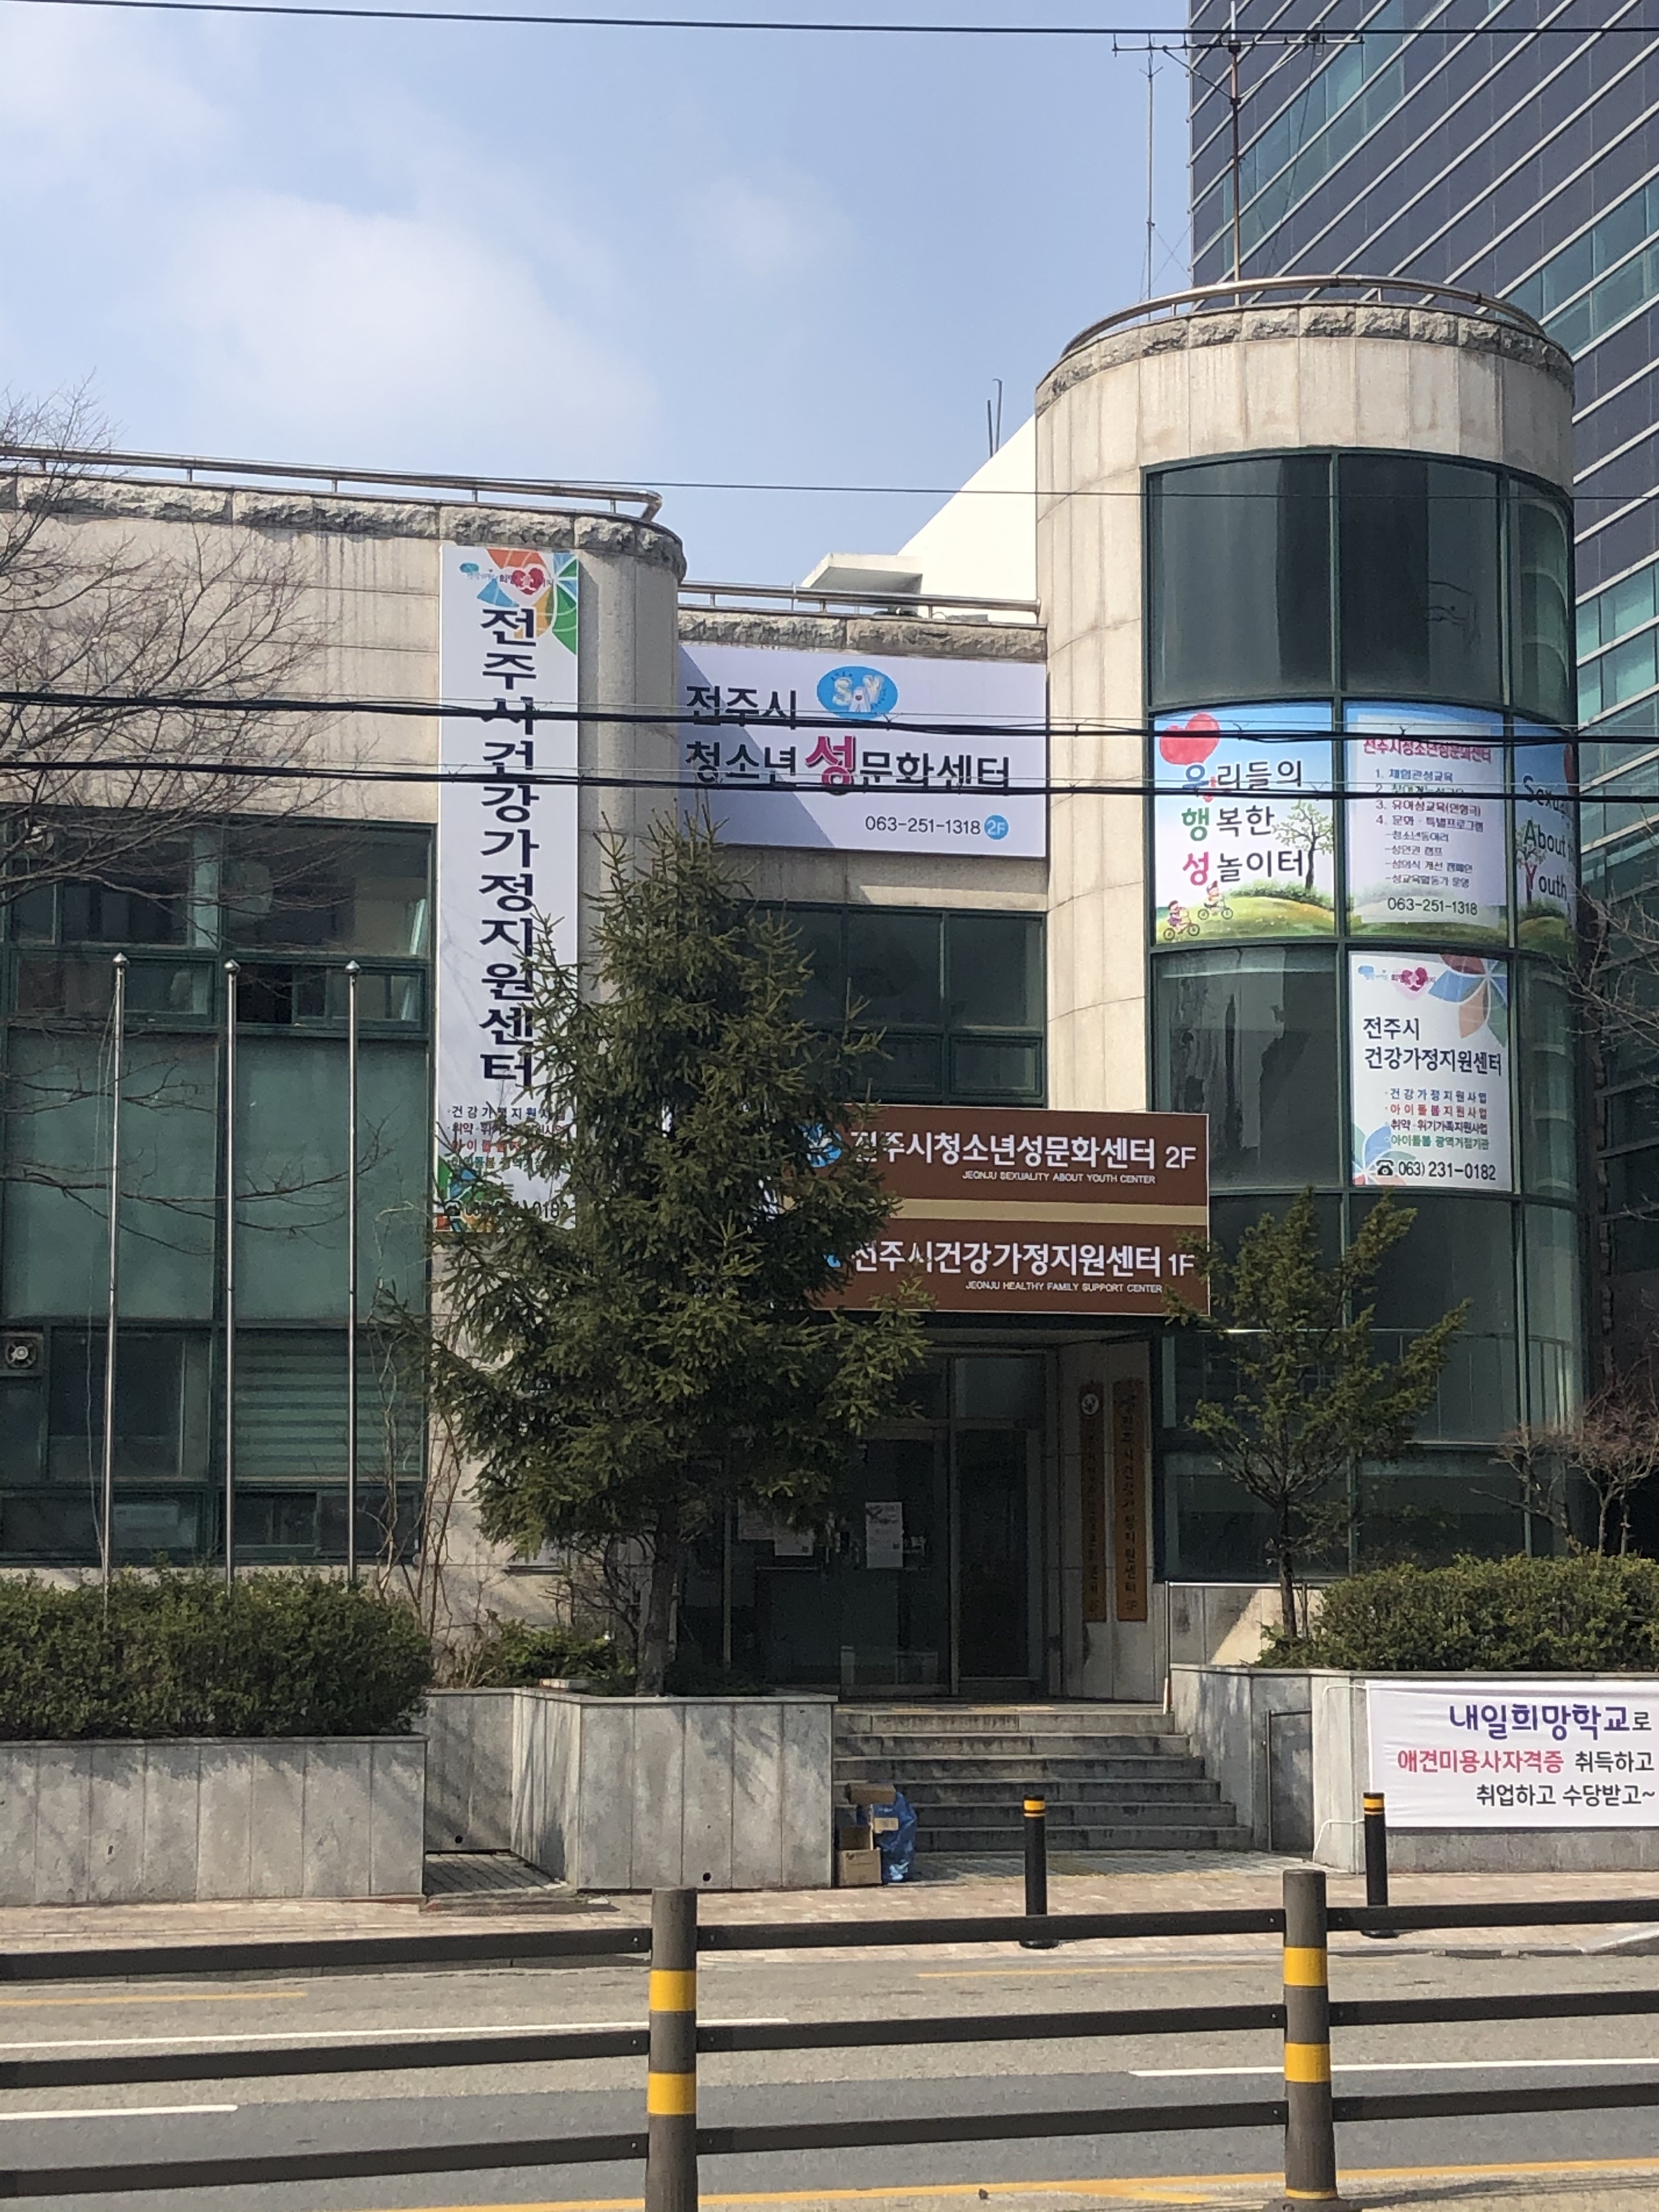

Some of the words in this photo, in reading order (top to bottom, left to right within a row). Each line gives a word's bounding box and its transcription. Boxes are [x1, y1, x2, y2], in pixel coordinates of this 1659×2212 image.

[686, 685, 797, 730] 전주시
[1182, 760, 1302, 793] 우리들의
[865, 816, 981, 836] 063-251-1318
[986, 819, 1007, 836] 2F
[1182, 805, 1275, 841] 행복한
[1523, 819, 1566, 857] About
[1524, 863, 1567, 901] Youth
[1387, 897, 1478, 916] 063-251-1318
[1362, 1017, 1420, 1041] 전주시
[1364, 1046, 1502, 1076] 건강가정지원센터
[1165, 1147, 1197, 1169] 2F
[962, 1170, 997, 1180] JEONJU
[1000, 1171, 1050, 1181] SEXUALITY
[1053, 1173, 1084, 1182] ABOUT
[1086, 1173, 1118, 1183] YOUTH
[1120, 1175, 1156, 1184] CENTER
[1168, 1253, 1195, 1276] 1F
[965, 1280, 1000, 1290] JEONJU
[1003, 1282, 1043, 1291] HEALTHY
[1047, 1282, 1079, 1291] FAMILY
[1082, 1283, 1124, 1293] SUPPORT
[1127, 1284, 1163, 1294] CENTER
[1449, 1704, 1652, 1741] 내일희망학교로
[1397, 1750, 1564, 1774] 애견미용사자격증
[1575, 1751, 1655, 1774] 취득하고
[1476, 1784, 1556, 1807] 취업하고
[1562, 1784, 1656, 1807] 수당받고~
